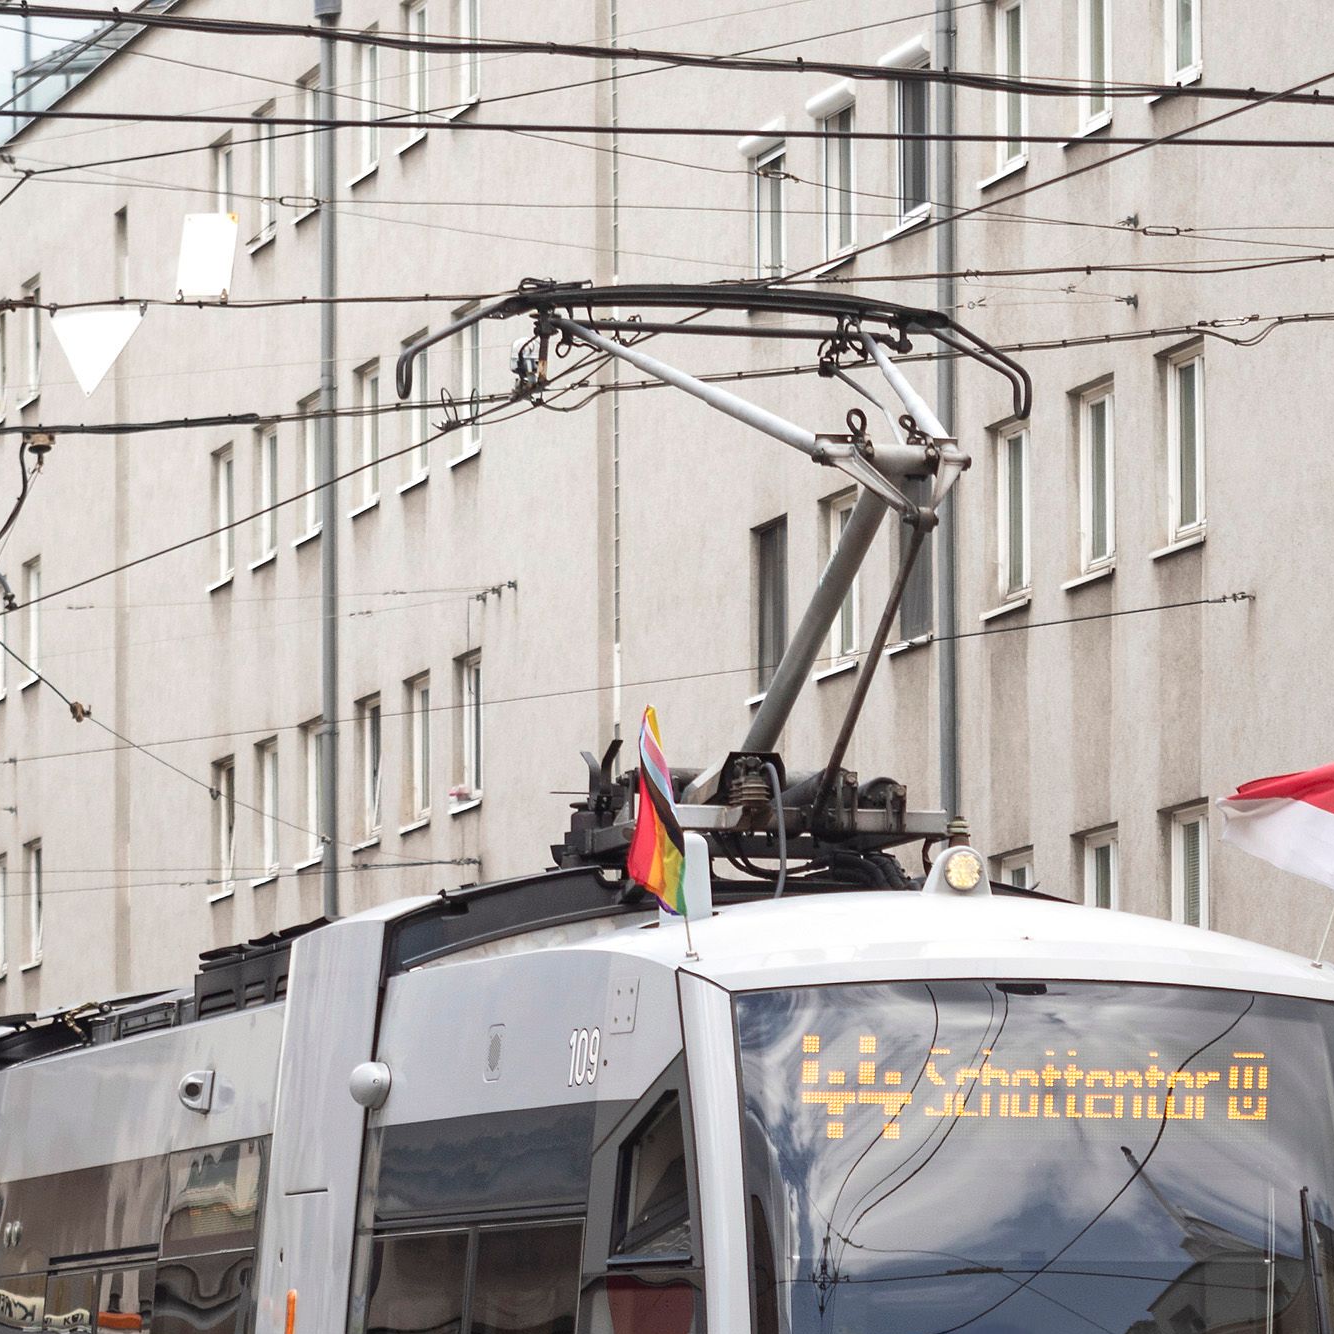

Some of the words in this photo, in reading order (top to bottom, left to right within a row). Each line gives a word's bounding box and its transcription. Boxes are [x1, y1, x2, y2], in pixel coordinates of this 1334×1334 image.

[568, 1026, 601, 1087] 109
[801, 1035, 912, 1139] 44
[925, 1048, 1220, 1118] Schottentor
